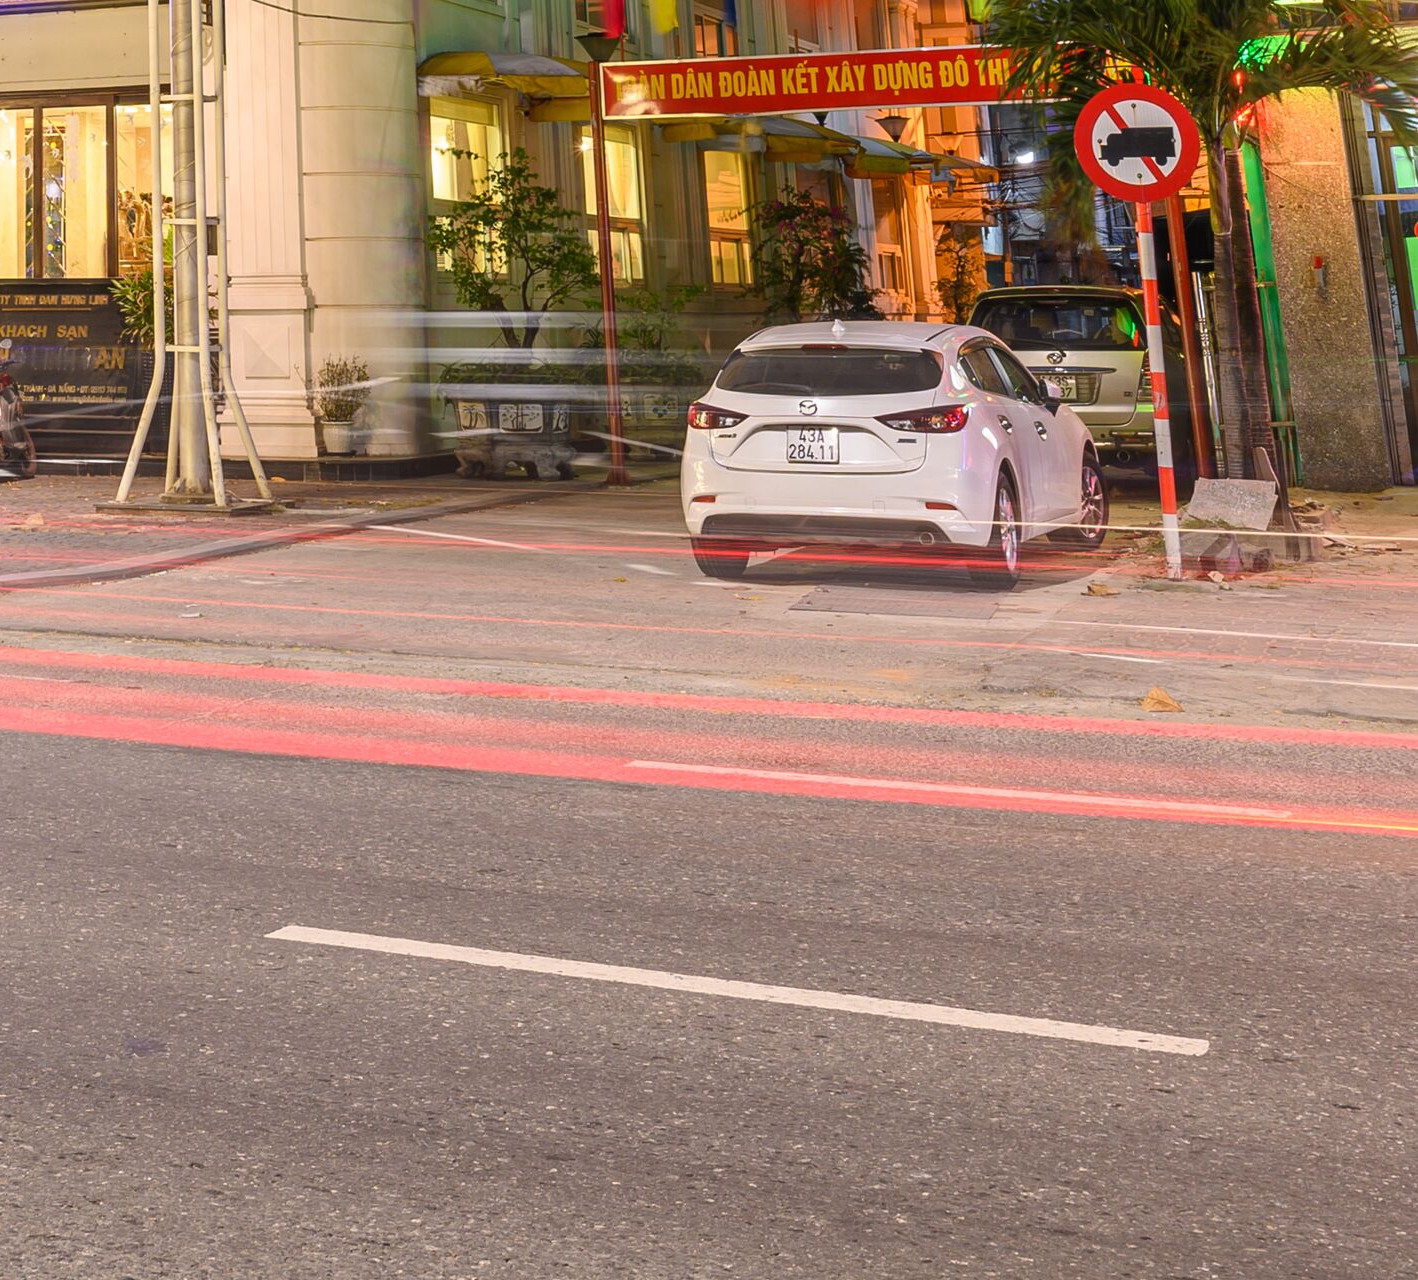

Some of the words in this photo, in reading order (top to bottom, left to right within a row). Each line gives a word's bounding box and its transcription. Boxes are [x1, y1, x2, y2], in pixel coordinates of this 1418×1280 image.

[671, 67, 713, 100] DÂN
[719, 65, 776, 98] ĐOÀN
[782, 60, 819, 95] KẾT
[825, 61, 866, 93] XÂY
[873, 59, 933, 96] DỰNG
[939, 54, 970, 88] ĐÔ
[798, 428, 825, 443] 43A
[788, 443, 834, 460] 284.11
